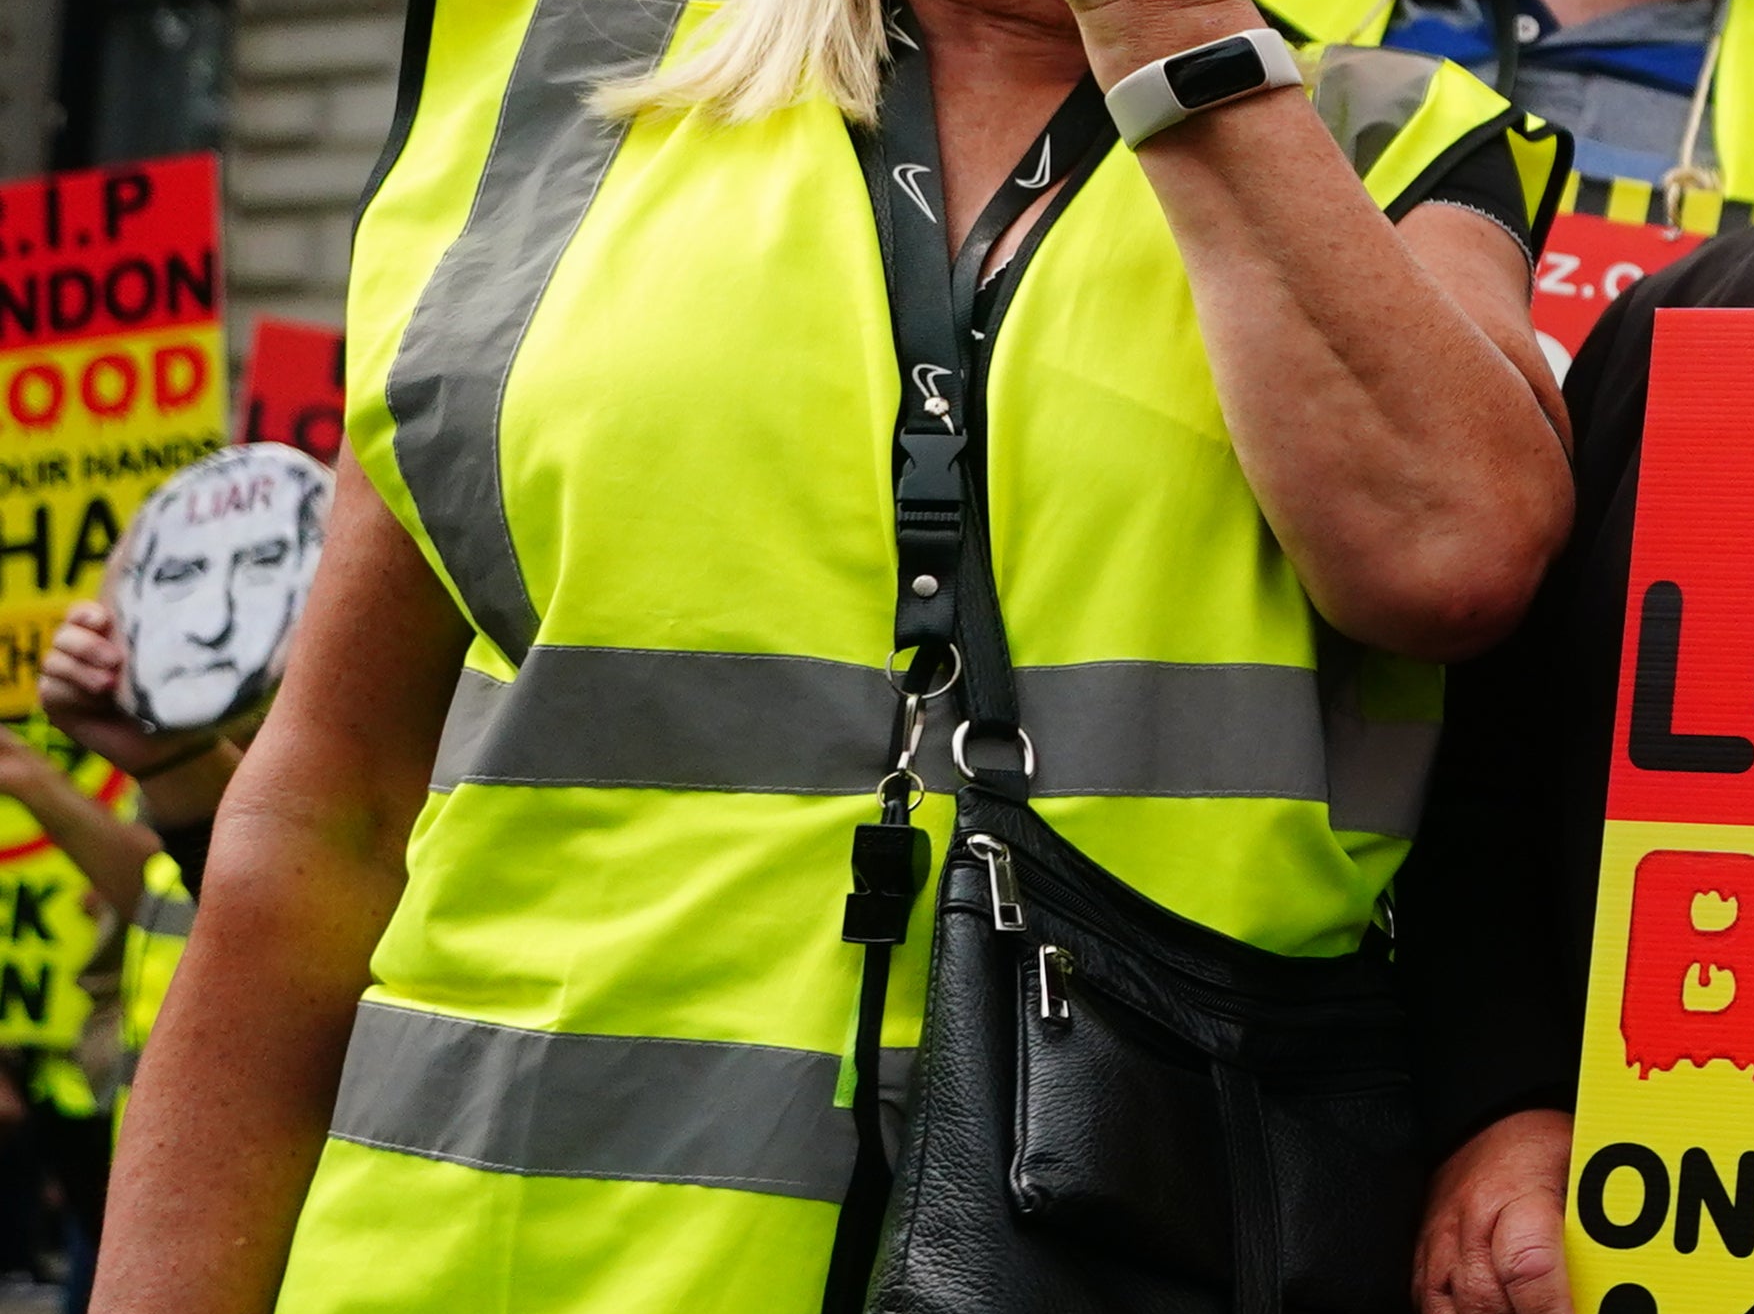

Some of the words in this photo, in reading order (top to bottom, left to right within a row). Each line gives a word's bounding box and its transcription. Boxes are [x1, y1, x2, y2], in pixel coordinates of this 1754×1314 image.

[0, 173, 152, 257] .I.P
[0, 250, 214, 335] NDON
[0, 342, 208, 437] OOD
[186, 475, 276, 524] LIAR
[0, 498, 124, 591] HA
